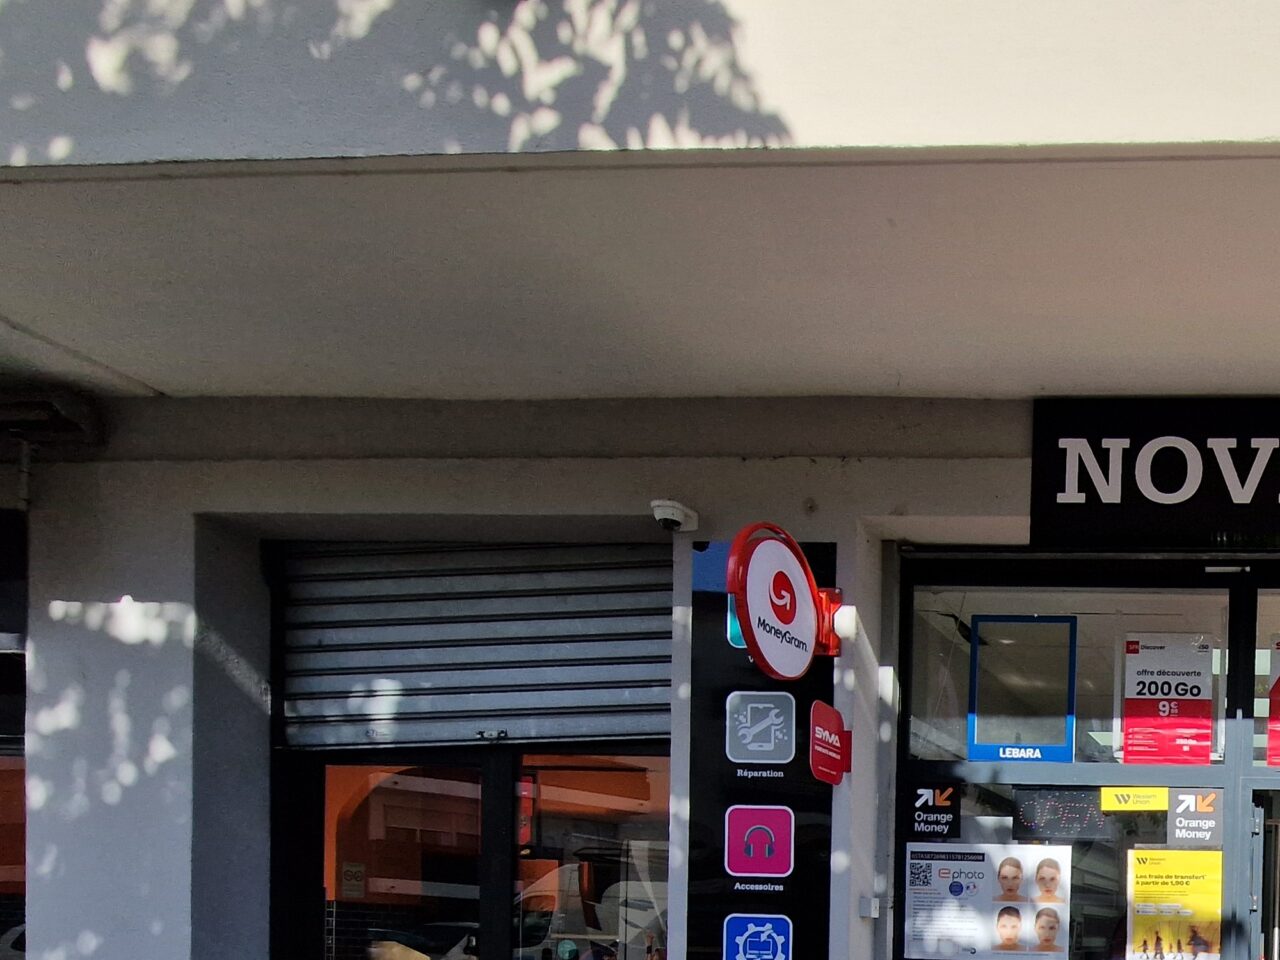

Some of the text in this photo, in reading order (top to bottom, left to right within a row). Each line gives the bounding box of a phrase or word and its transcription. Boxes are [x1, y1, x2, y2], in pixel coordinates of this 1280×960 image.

[757, 616, 808, 651] MoneyGram
[1156, 669, 1201, 677] découverte
[815, 726, 840, 748] SYMA
[998, 748, 1042, 759] LEBARA
[736, 768, 784, 778] Réparation
[914, 811, 953, 822] Orange
[1019, 800, 1105, 829] OPEN
[914, 822, 949, 834] Money
[1175, 817, 1216, 829] Orange
[1175, 829, 1212, 840] Money
[734, 882, 784, 891] Accessoires
